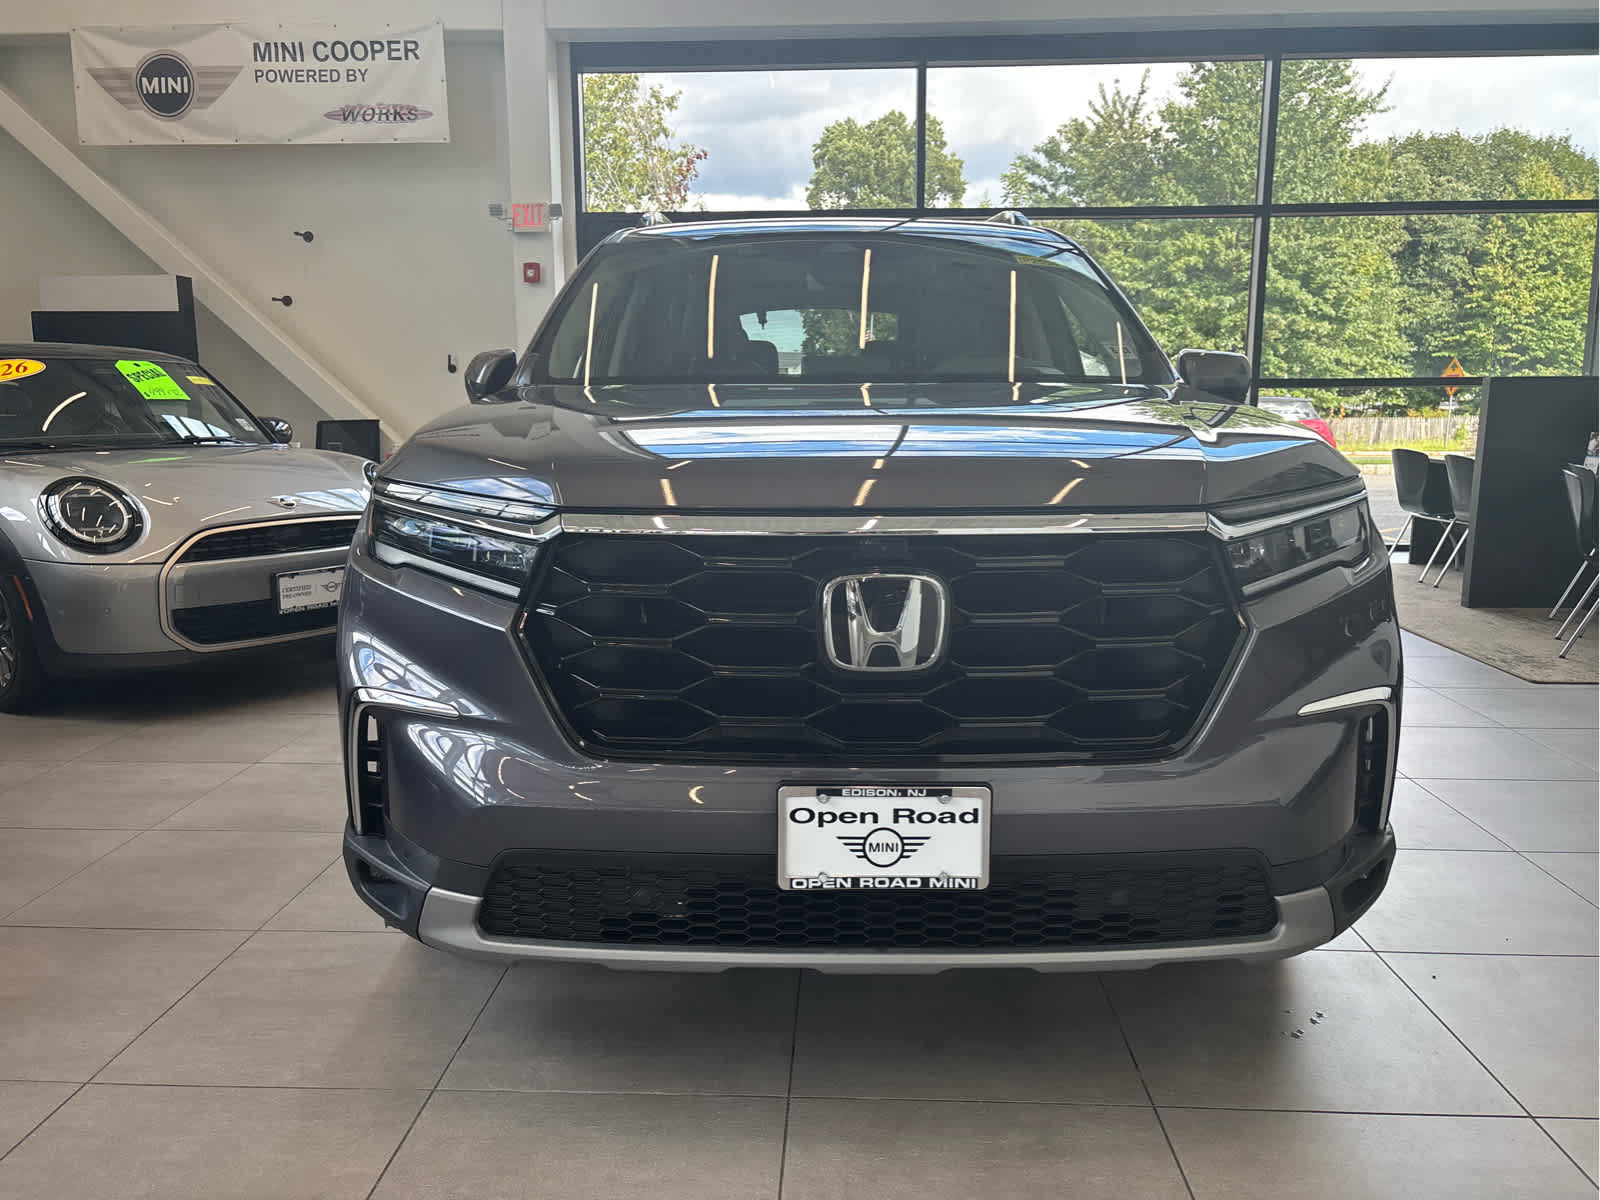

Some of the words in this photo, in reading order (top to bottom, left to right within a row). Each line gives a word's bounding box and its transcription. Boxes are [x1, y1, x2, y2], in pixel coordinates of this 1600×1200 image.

[253, 41, 305, 63] MINI
[313, 39, 420, 62] COOPER
[254, 69, 341, 83] POWERED
[346, 68, 368, 83] BY
[140, 76, 190, 95] MINI
[342, 107, 418, 122] WORKS
[512, 203, 543, 228] EXIT
[126, 367, 167, 383] SPECIAL
[907, 788, 927, 797] NJ
[789, 808, 879, 828] Open
[893, 808, 979, 824] Road
[868, 842, 899, 853] MINI
[791, 877, 852, 889] OPEN
[859, 877, 922, 889] ROAD
[929, 877, 977, 889] MINI
